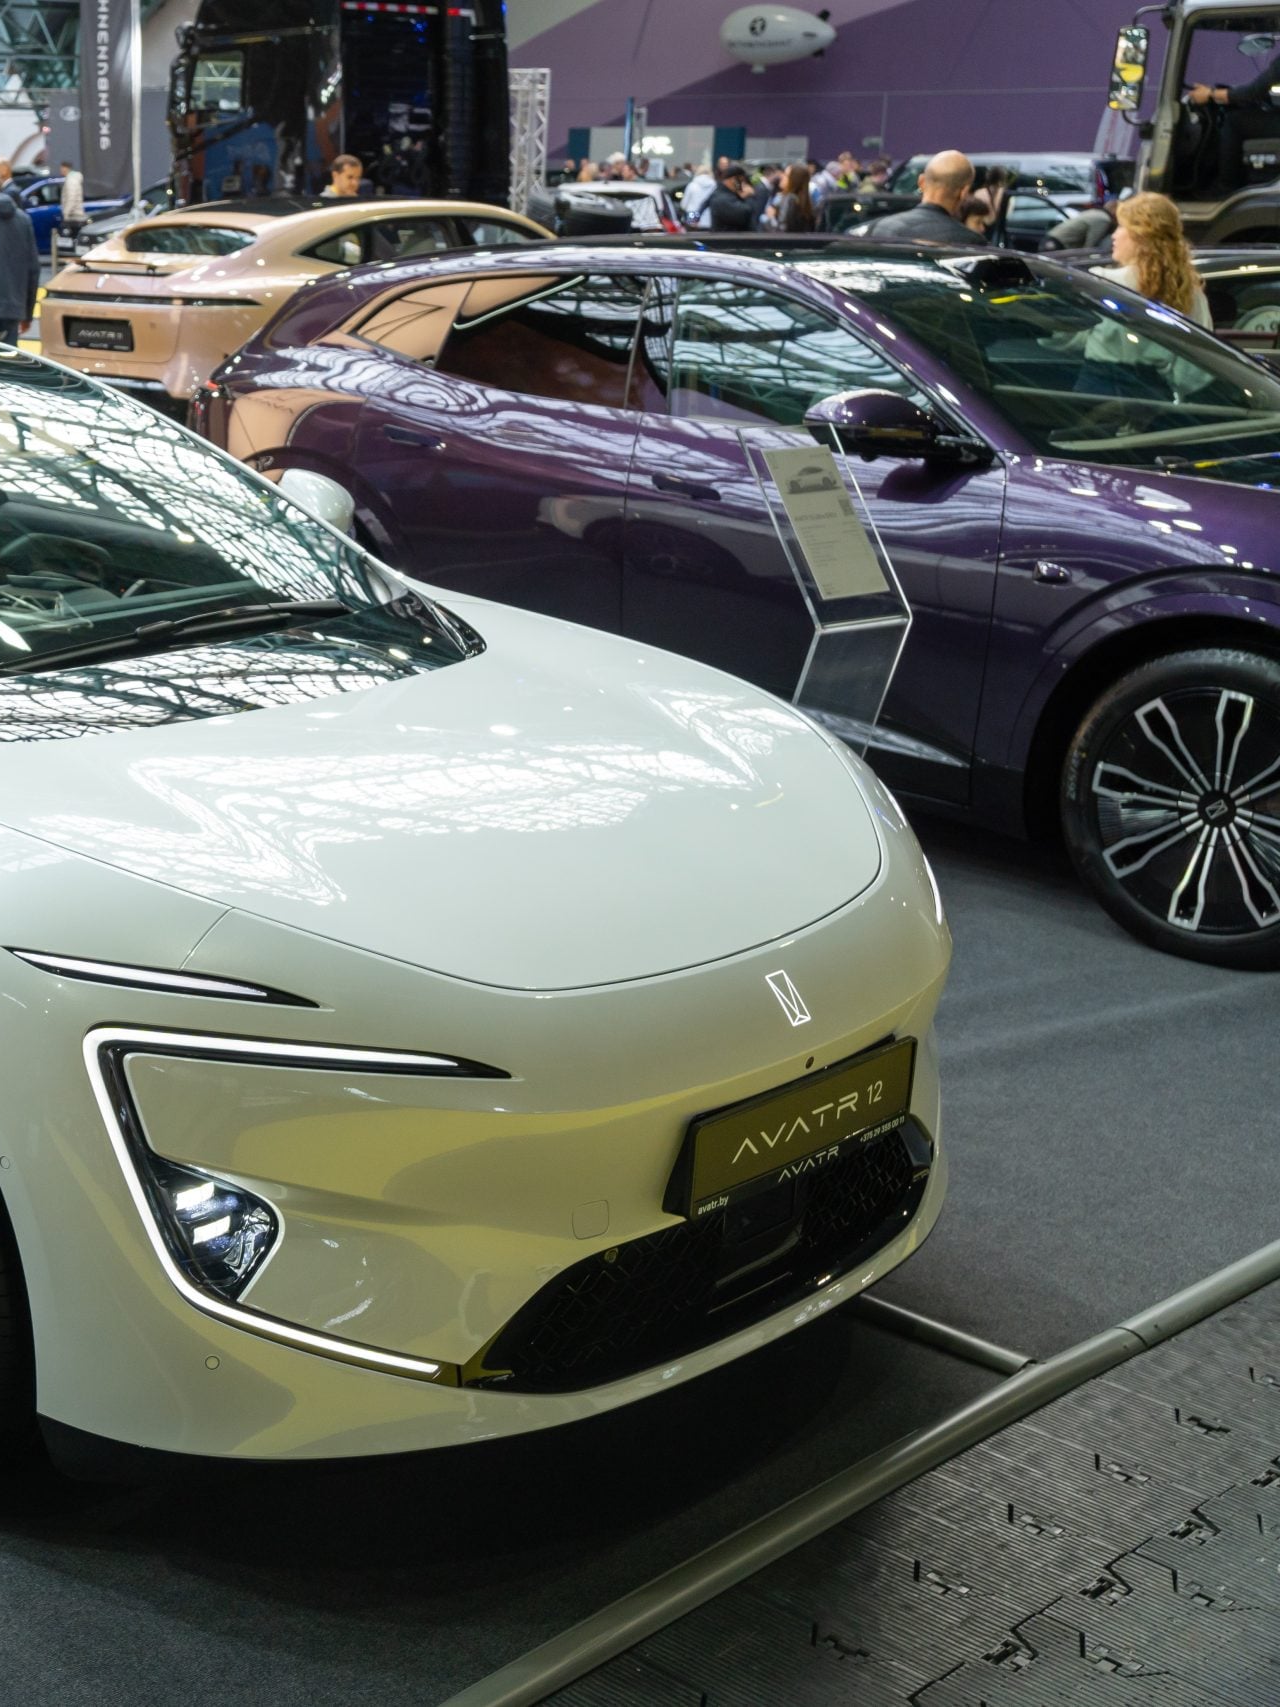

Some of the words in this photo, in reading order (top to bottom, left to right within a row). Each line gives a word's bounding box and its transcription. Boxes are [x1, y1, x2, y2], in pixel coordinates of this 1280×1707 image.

[732, 1092, 859, 1164] AVATR
[867, 1080, 883, 1105] 12
[778, 1145, 839, 1183] AVATR
[697, 1194, 729, 1215] avatr.by
